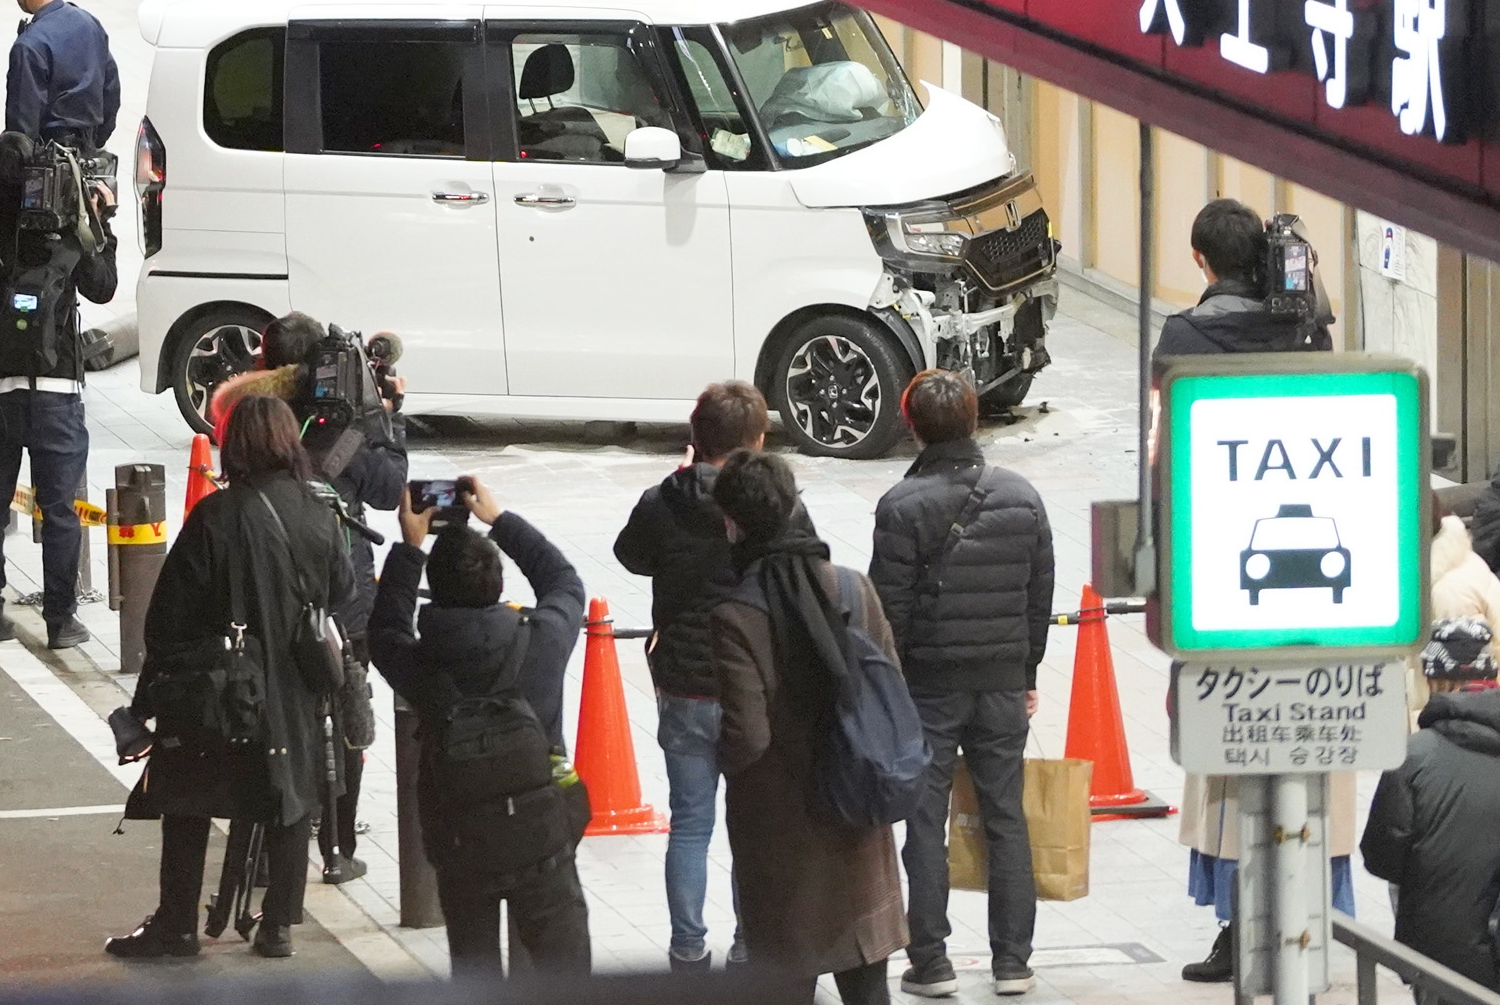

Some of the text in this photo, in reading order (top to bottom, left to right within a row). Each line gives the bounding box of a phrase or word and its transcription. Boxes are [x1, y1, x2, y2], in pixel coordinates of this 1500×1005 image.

[1217, 436, 1372, 482] TAXI
[1196, 664, 1386, 700] タクシーのりば
[1221, 701, 1367, 722] Taxi Stand
[1222, 724, 1362, 744] 出租车乘车处
[1289, 746, 1359, 767] 승강장
